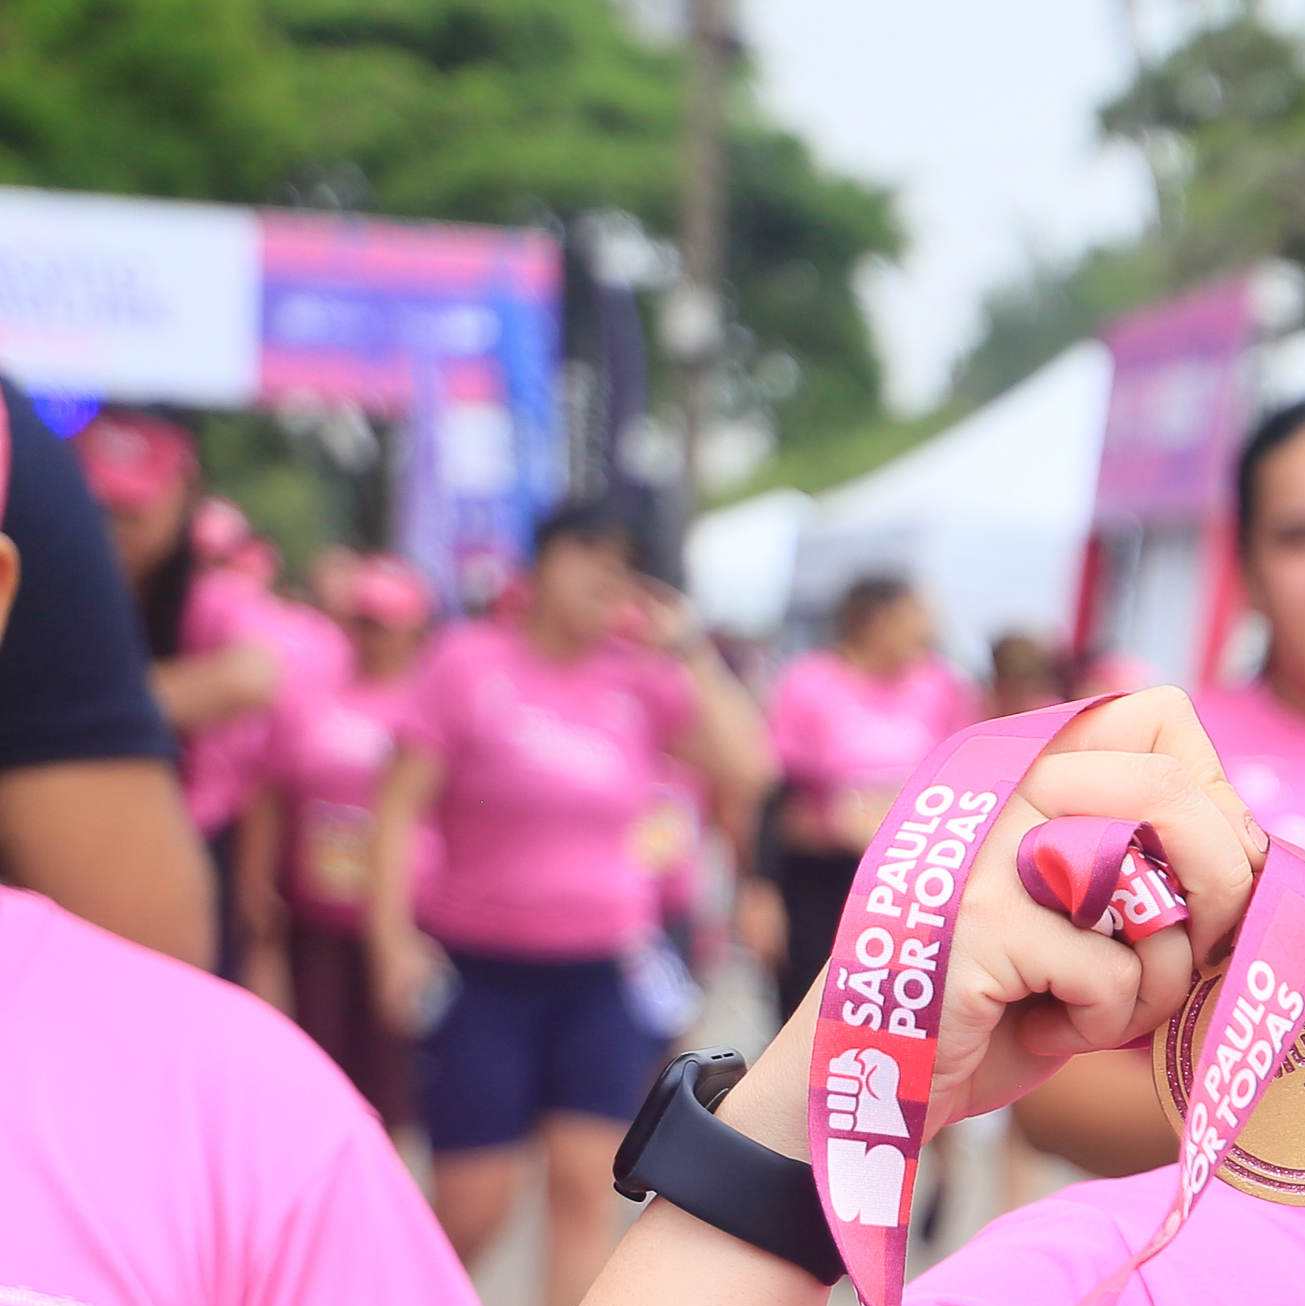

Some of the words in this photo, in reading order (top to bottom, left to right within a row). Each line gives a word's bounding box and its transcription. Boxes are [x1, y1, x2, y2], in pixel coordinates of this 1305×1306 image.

[865, 784, 956, 918] PAULO
[905, 790, 999, 930] TODAS
[836, 927, 895, 1032] SÃO
[887, 937, 942, 1040] POR
[1203, 959, 1277, 1103] PAULO
[1215, 981, 1305, 1129] TODAS
